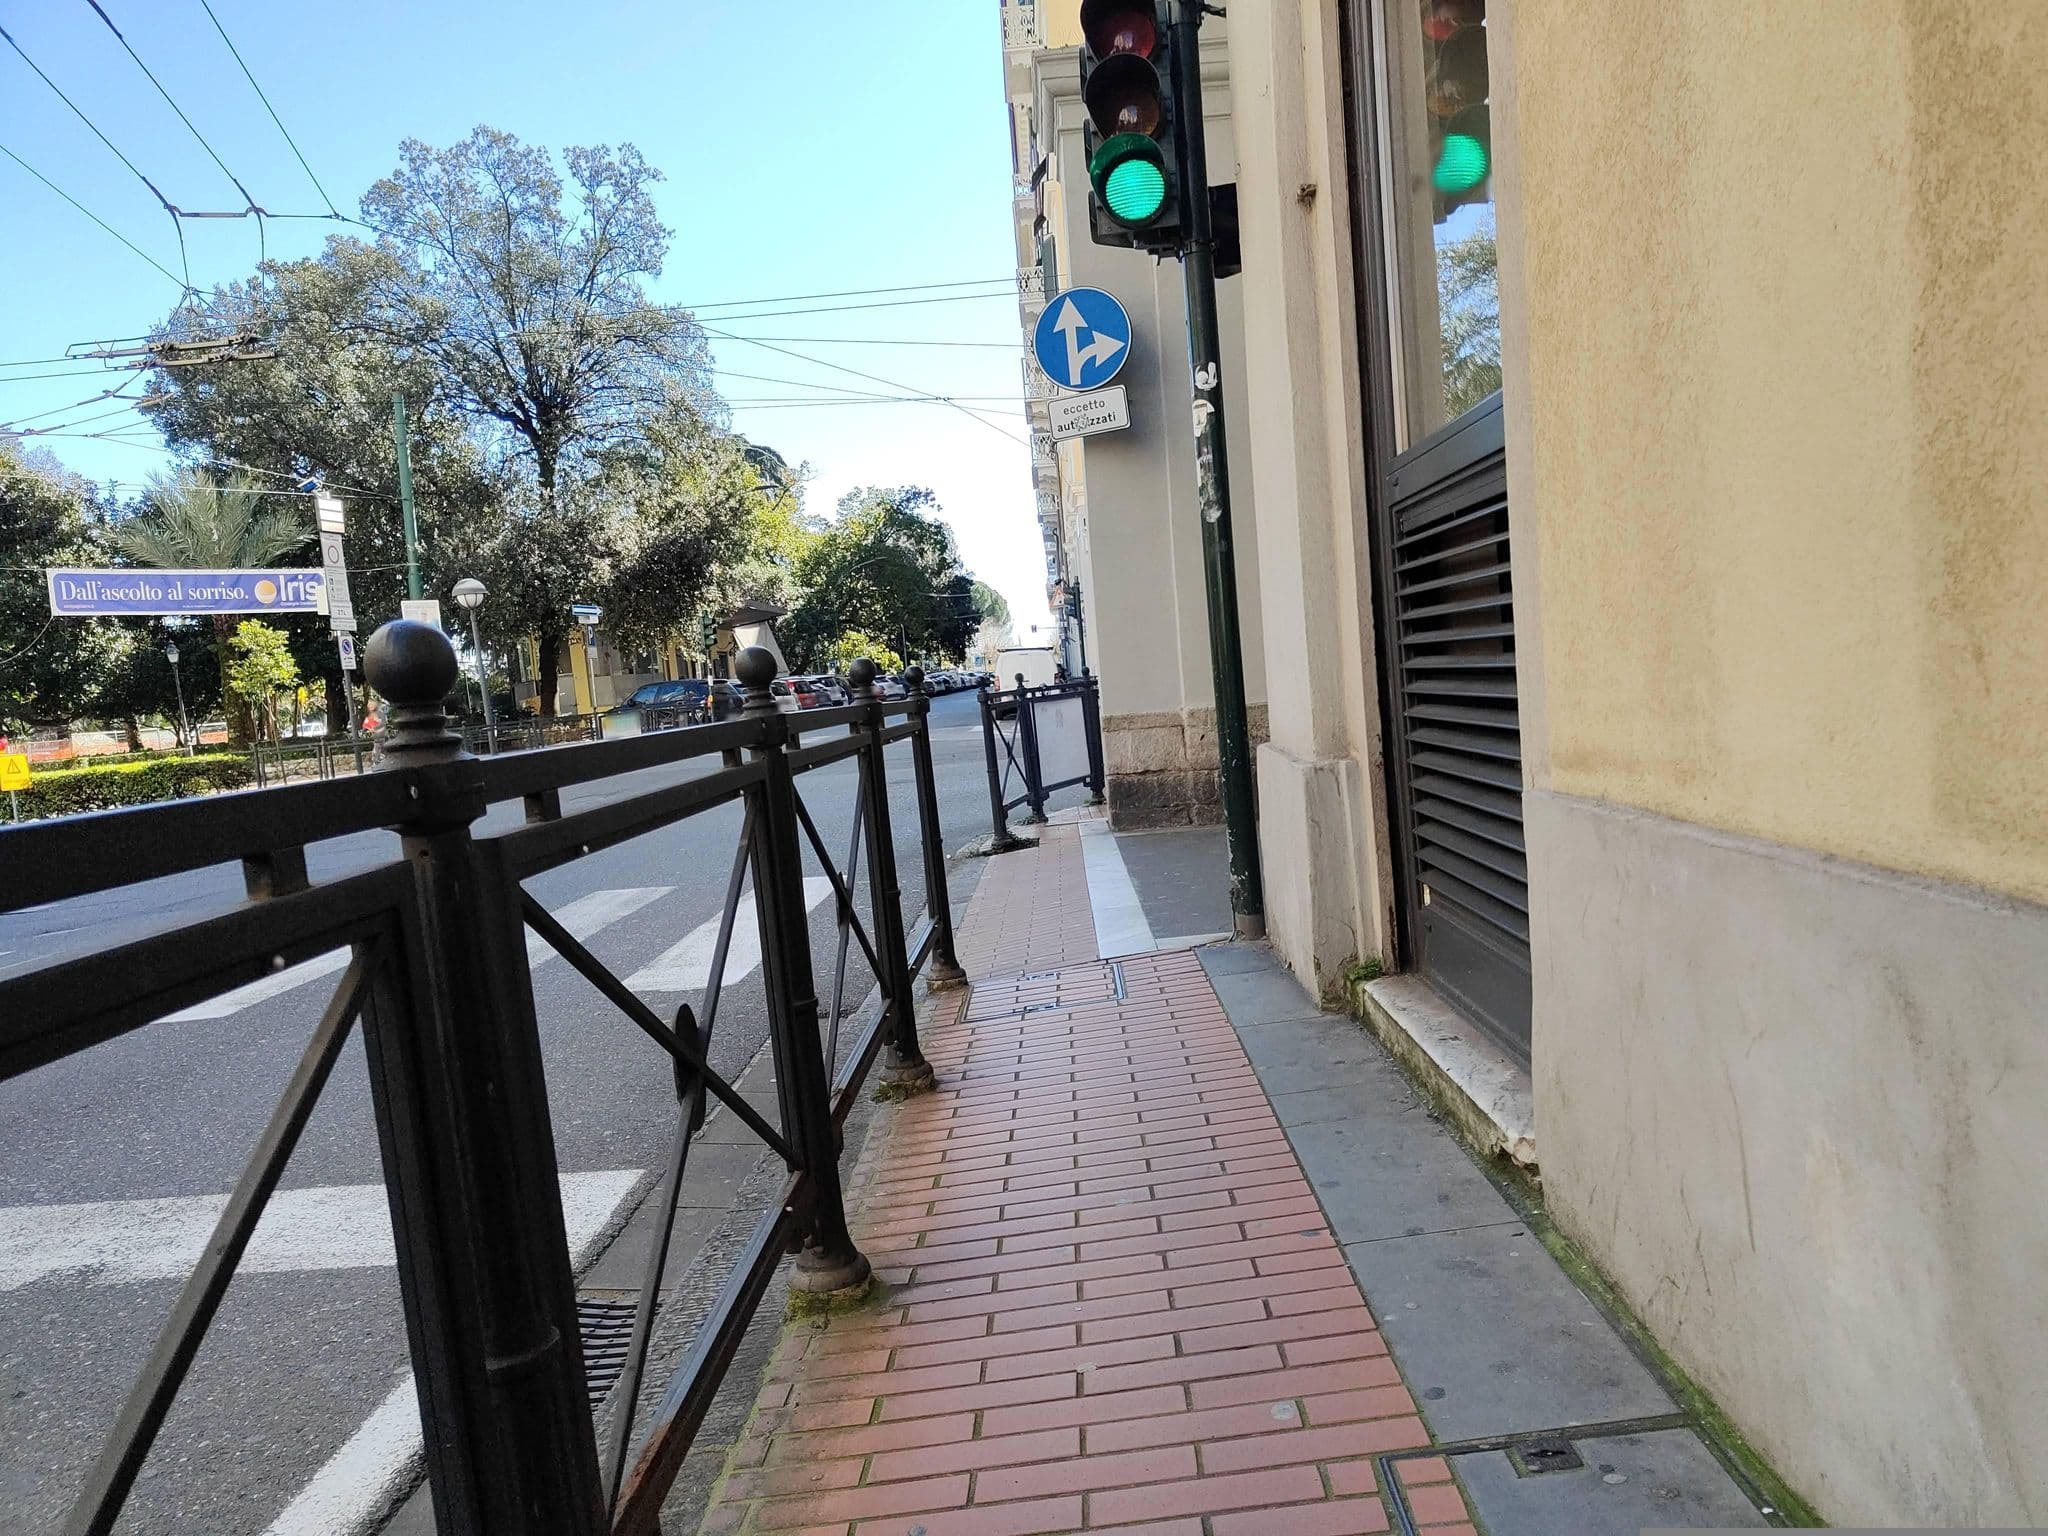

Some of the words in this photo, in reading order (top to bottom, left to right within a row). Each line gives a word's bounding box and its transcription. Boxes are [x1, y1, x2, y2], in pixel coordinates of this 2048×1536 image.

[1063, 400, 1105, 415] eccetto
[1057, 411, 1116, 432] autizzati
[60, 580, 162, 601] Dall'ascolto
[167, 581, 183, 601] al
[188, 581, 249, 601] sorriso.
[279, 574, 318, 601] Iris
